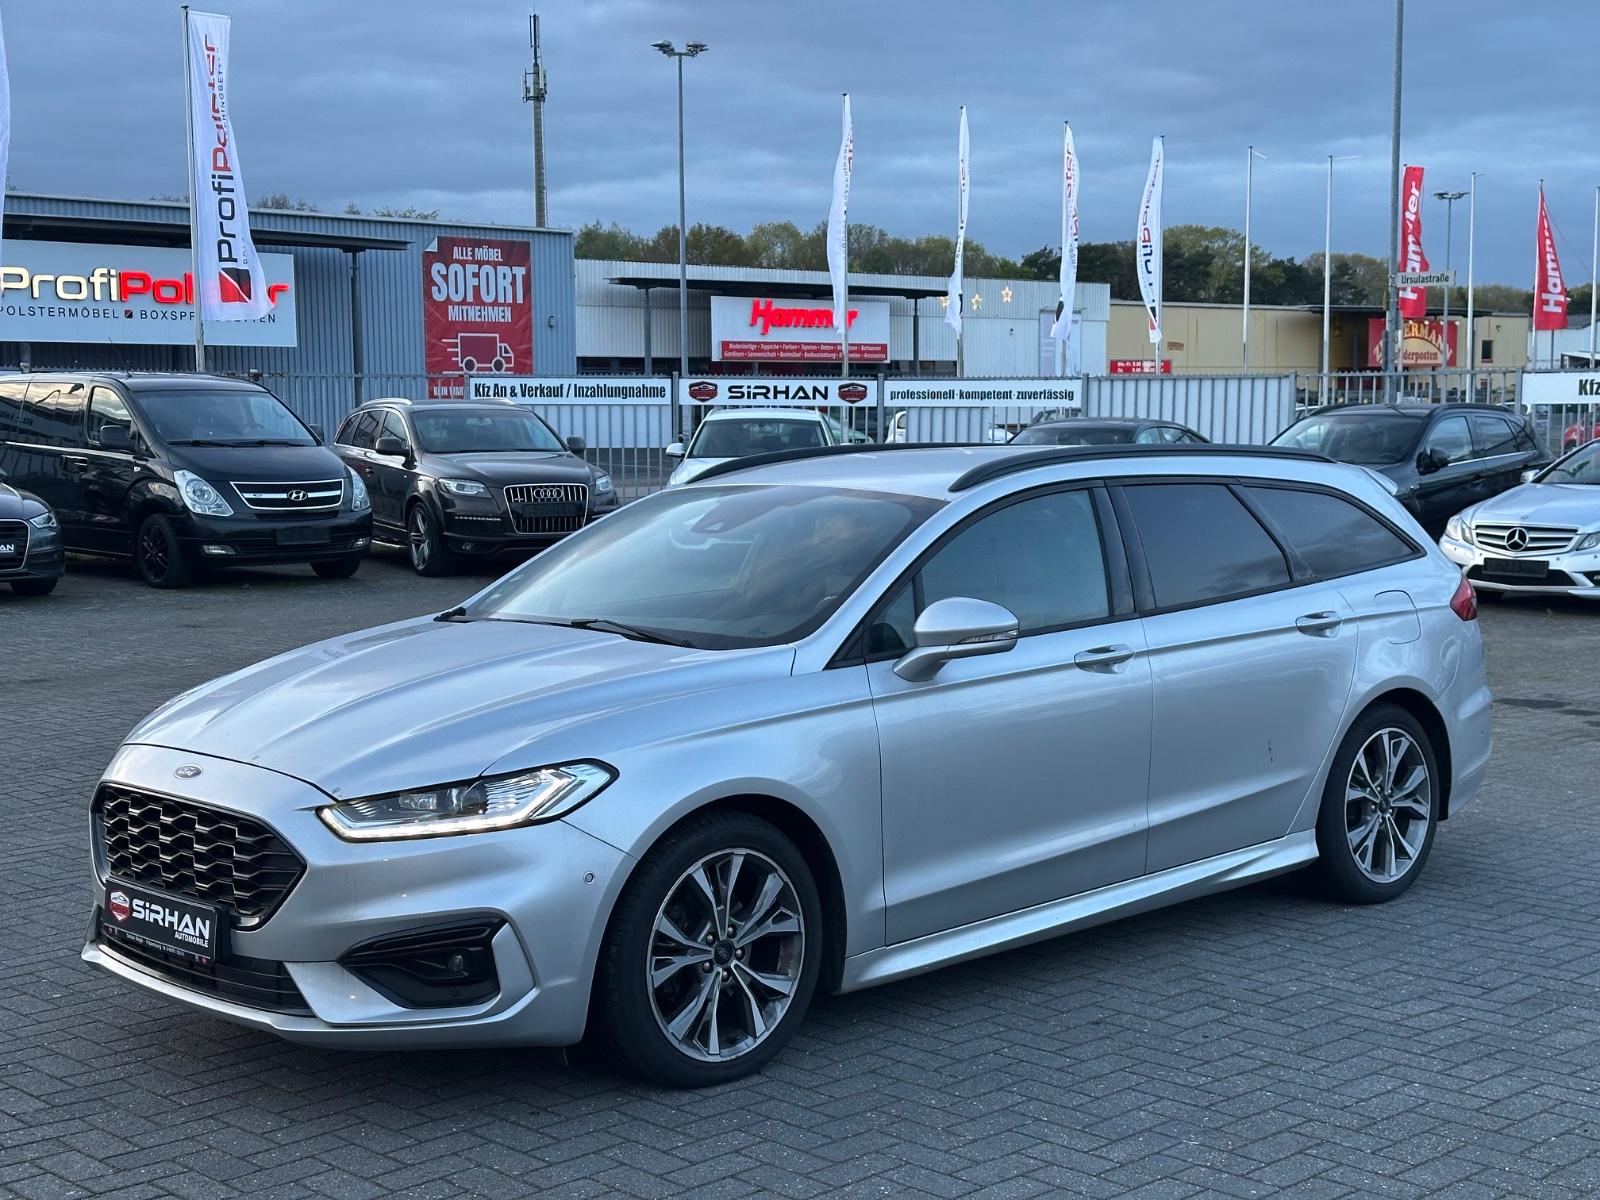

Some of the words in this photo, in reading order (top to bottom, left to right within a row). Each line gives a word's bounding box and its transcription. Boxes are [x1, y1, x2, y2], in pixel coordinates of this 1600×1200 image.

[453, 246, 473, 260] ALLE
[474, 245, 503, 261] MÖBEL
[431, 262, 526, 304] SOFORT
[1401, 273, 1449, 285] Ursulastraße
[448, 304, 512, 323] MITNEHMEN
[750, 297, 859, 336] Hammr
[474, 383, 491, 398] Kfz
[493, 383, 507, 398] An
[509, 384, 518, 398] &
[520, 383, 565, 398] Verkauf
[574, 384, 666, 400] Inzahlungnahme
[727, 384, 829, 401] SiRHAN
[890, 389, 956, 401] professionell
[959, 389, 1013, 402] kompetent
[131, 898, 210, 940] SiRHAN
[174, 931, 209, 948] AUTOMOBILE
